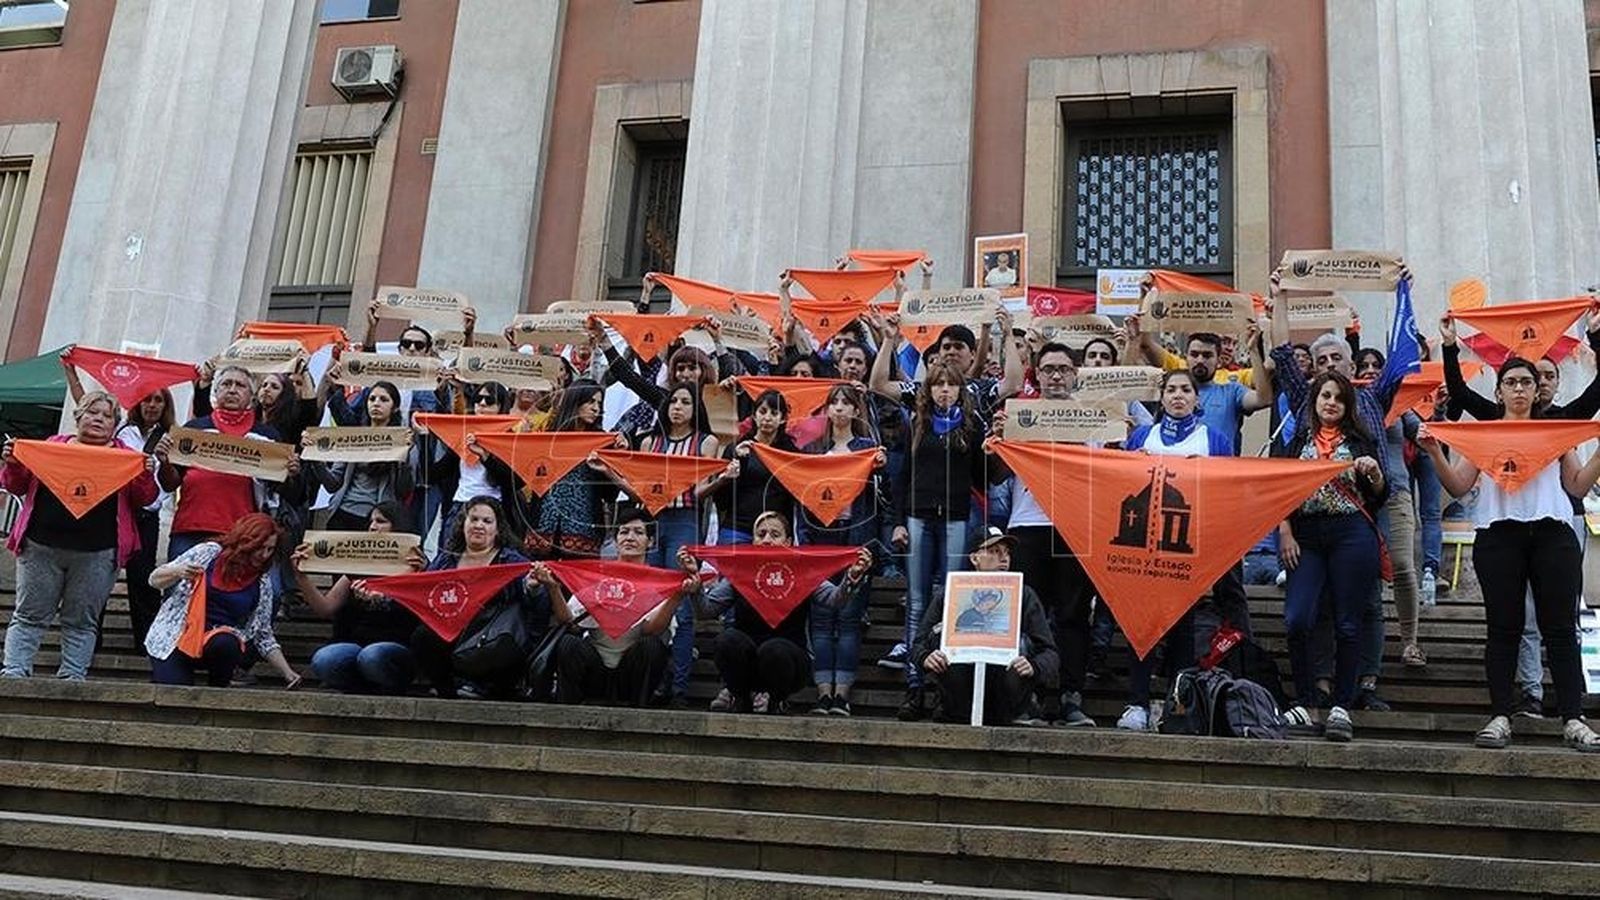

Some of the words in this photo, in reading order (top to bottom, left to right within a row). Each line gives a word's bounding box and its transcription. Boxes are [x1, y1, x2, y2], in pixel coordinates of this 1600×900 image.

[1316, 260, 1381, 269] #JUSTICIA
[928, 293, 985, 304] #JUSTICIA
[1171, 300, 1233, 309] #JUSTICIA
[1289, 303, 1335, 311] JUSTICIA
[452, 339, 498, 349] #JTICIA
[367, 360, 421, 369] #JUSTICIA
[488, 357, 543, 368] #JUSTICIA
[1086, 370, 1147, 381] #JUSTICIA
[1041, 409, 1107, 417] #JUSTICIA
[337, 434, 394, 443] #JUSTICIA
[201, 442, 262, 457] #JUSTICIA
[336, 540, 399, 549] #JUSTICIA
[1154, 559, 1192, 571] Estado
